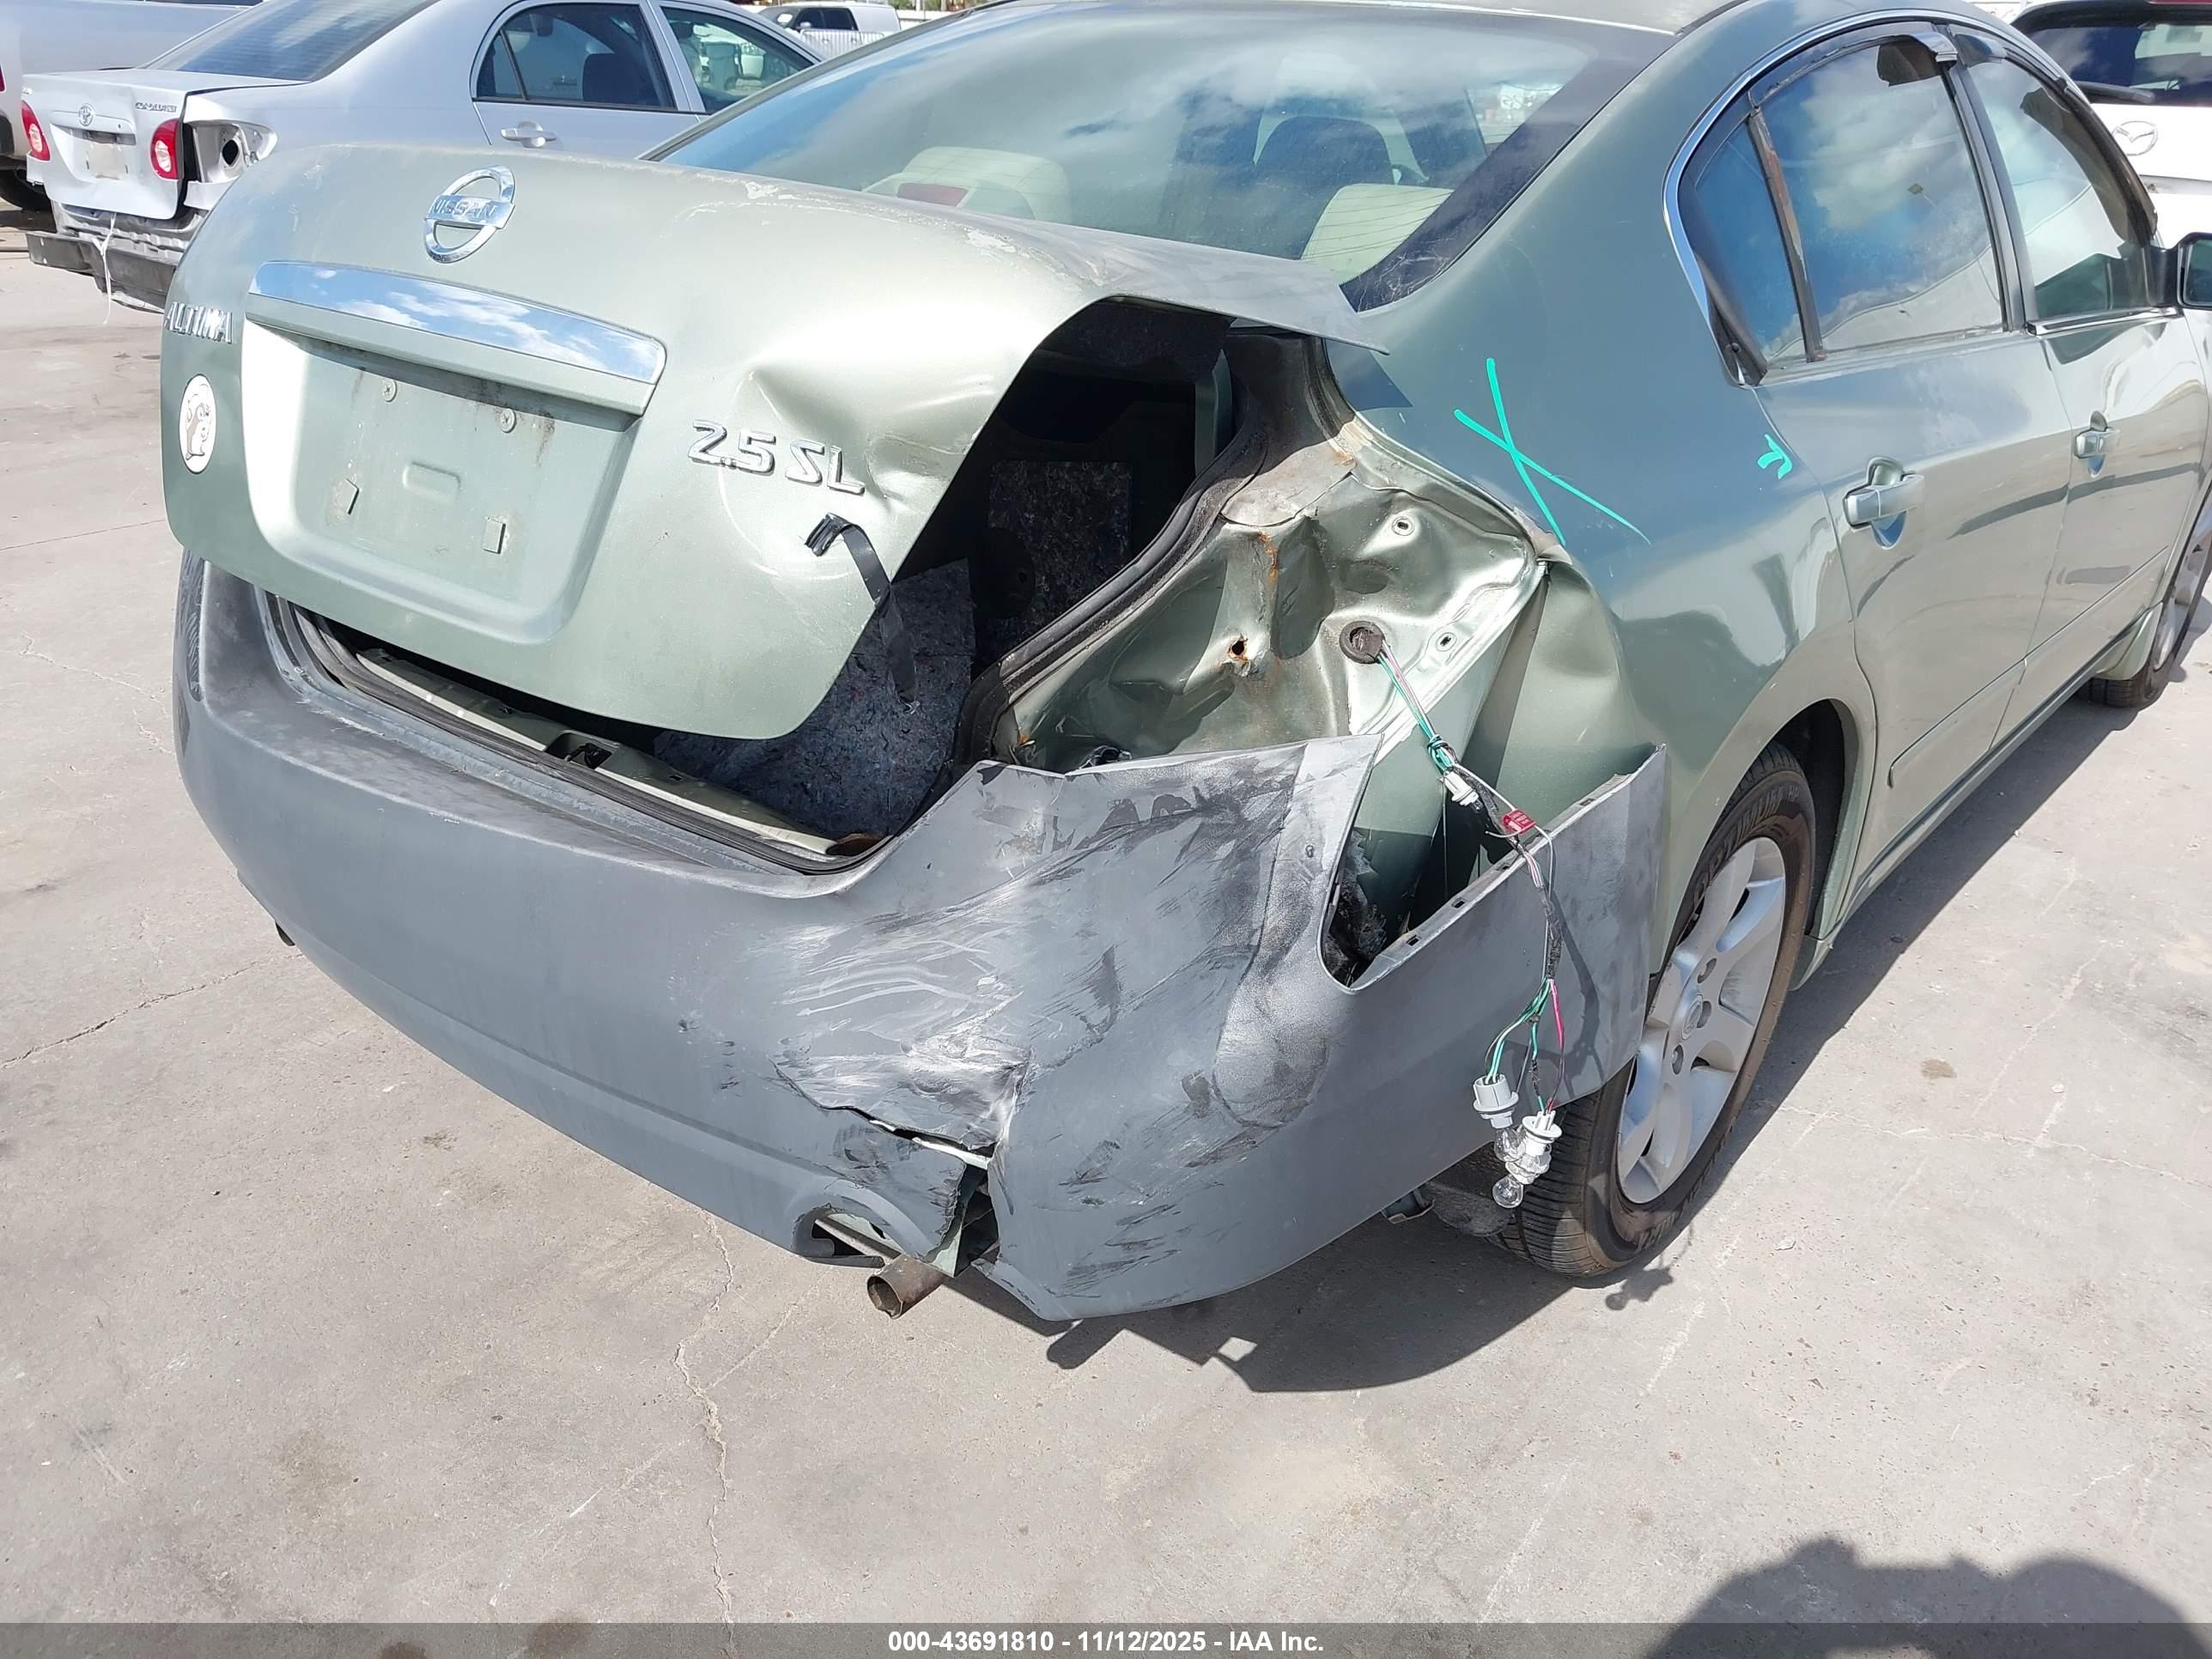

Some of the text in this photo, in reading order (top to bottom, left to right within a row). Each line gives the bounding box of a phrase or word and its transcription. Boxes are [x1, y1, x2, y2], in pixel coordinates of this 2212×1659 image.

[431, 199, 499, 220] NISSAN
[164, 302, 233, 343] ALTIMA
[688, 419, 866, 495] 2.5 SL
